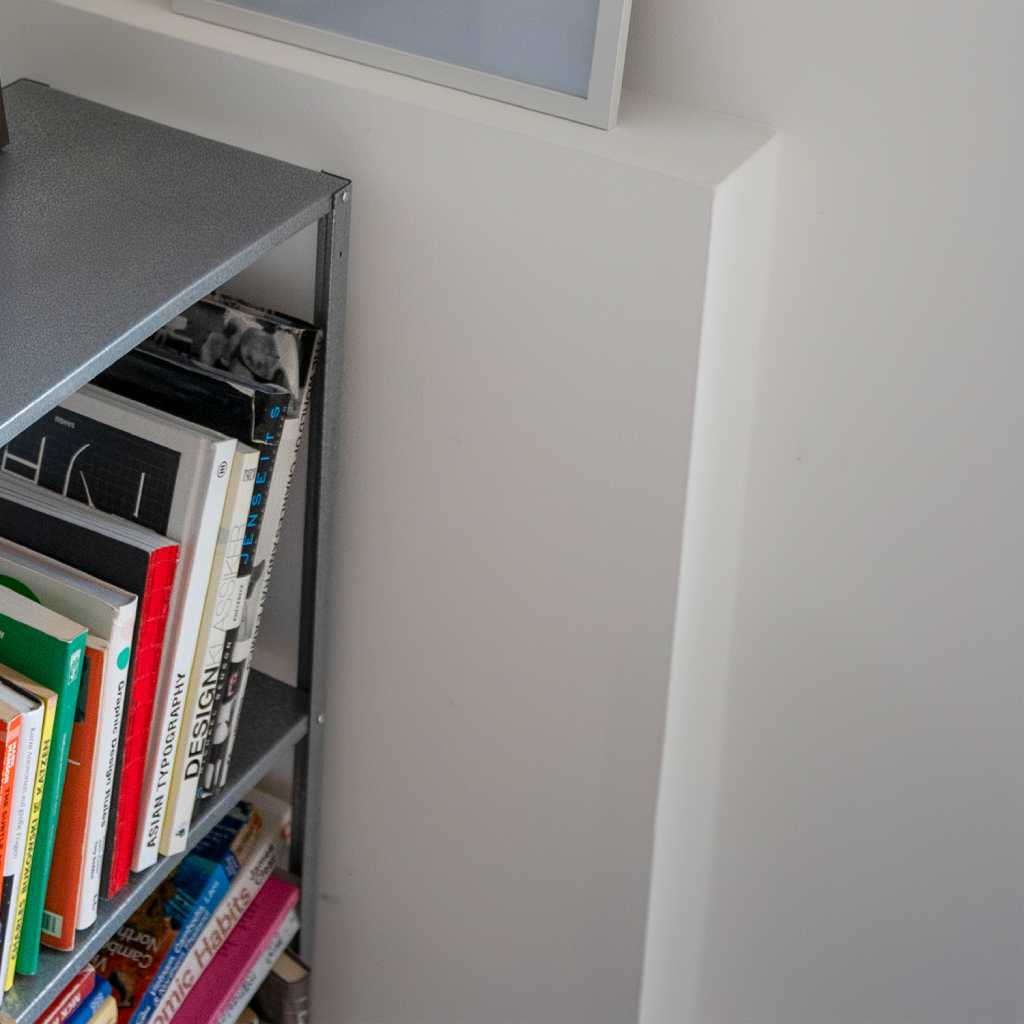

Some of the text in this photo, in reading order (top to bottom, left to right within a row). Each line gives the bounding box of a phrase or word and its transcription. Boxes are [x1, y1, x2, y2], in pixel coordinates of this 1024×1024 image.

[240, 406, 281, 566] JENSEITS
[36, 739, 50, 796] KATZEN
[101, 680, 125, 828] Graphic Design Rules
[147, 672, 186, 848] ASIAN TYPOGRAPHY
[194, 887, 251, 969] Habits
